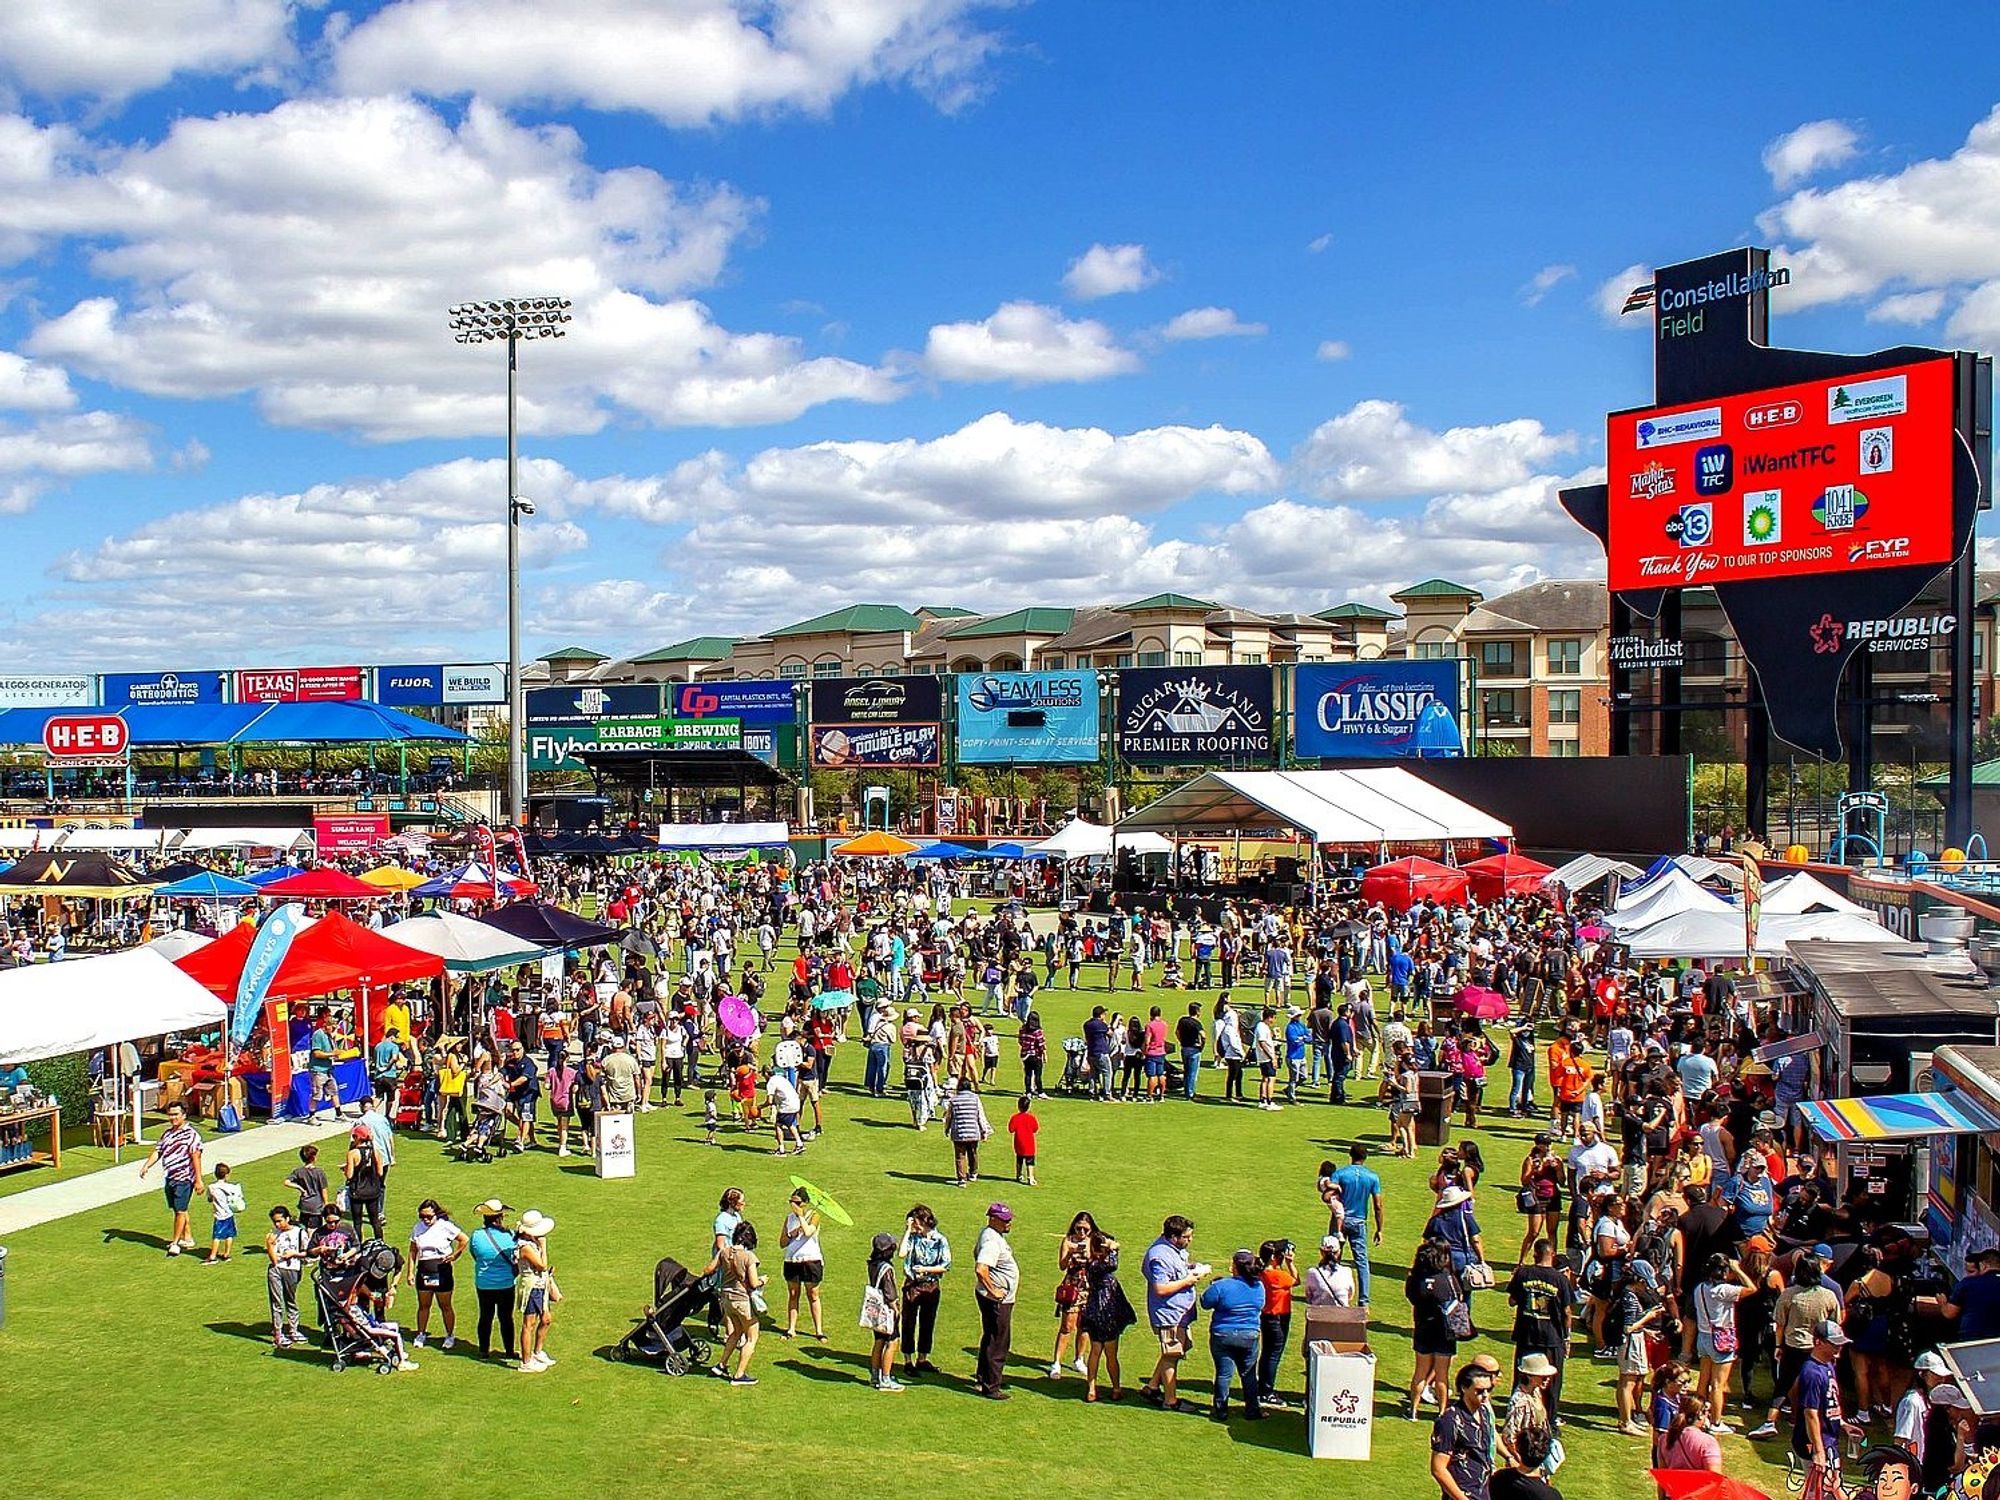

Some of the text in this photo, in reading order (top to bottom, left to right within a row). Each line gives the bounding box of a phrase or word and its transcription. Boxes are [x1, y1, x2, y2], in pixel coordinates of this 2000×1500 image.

[1660, 267, 1791, 311] Constellation
[1660, 309, 1704, 340] Field
[1854, 393, 1894, 406] EVERGREEN
[1657, 418, 1722, 436] BHC-BEHAVIORAL
[1743, 444, 1837, 476] iWantTFC
[1702, 474, 1725, 487] TFC
[1764, 492, 1777, 503] bp
[1665, 522, 1685, 532] abc
[1685, 514, 1707, 536] 13
[1826, 514, 1853, 528] KRBE
[1866, 537, 1910, 553] FYP
[1866, 550, 1910, 561] HOUSTON
[1638, 545, 1833, 582] Thank You TO OUR TOP SPONSORS
[1846, 615, 1958, 639] REPUBLIC
[1610, 638, 1684, 659] Methodist
[1869, 637, 1929, 653] SERVICES
[1619, 659, 1684, 669] LEADING MEDICINE
[31, 680, 88, 690] GENERATOR
[246, 675, 294, 693] TEXAS
[1404, 681, 1435, 692] locations
[129, 688, 199, 699] ORTHODONTICS
[720, 694, 741, 702] CAPITAL
[742, 693, 766, 701] PLASTICS
[980, 676, 1082, 707] SEAMLESS
[1030, 697, 1080, 707] SOLUTIONS
[1127, 681, 1262, 729] SUGAR LAND
[599, 724, 740, 738] KARBACH BREWING
[1342, 724, 1365, 734] HWY
[1366, 723, 1373, 734] 6
[1374, 723, 1381, 734] &
[1382, 723, 1408, 736] Sugar
[856, 726, 936, 755] DOUBLE PLAY
[963, 739, 984, 747] COPY
[988, 738, 1013, 746] PRINT
[1018, 738, 1040, 746] SCAN
[1057, 737, 1099, 746] SERVICES
[1124, 736, 1269, 751] PREMIER ROOFING
[889, 745, 916, 761] Crush
[357, 801, 372, 810] BEER
[389, 801, 404, 810] FOOD
[36, 859, 77, 883] N
[1320, 1415, 1368, 1425] REPUBLIC
